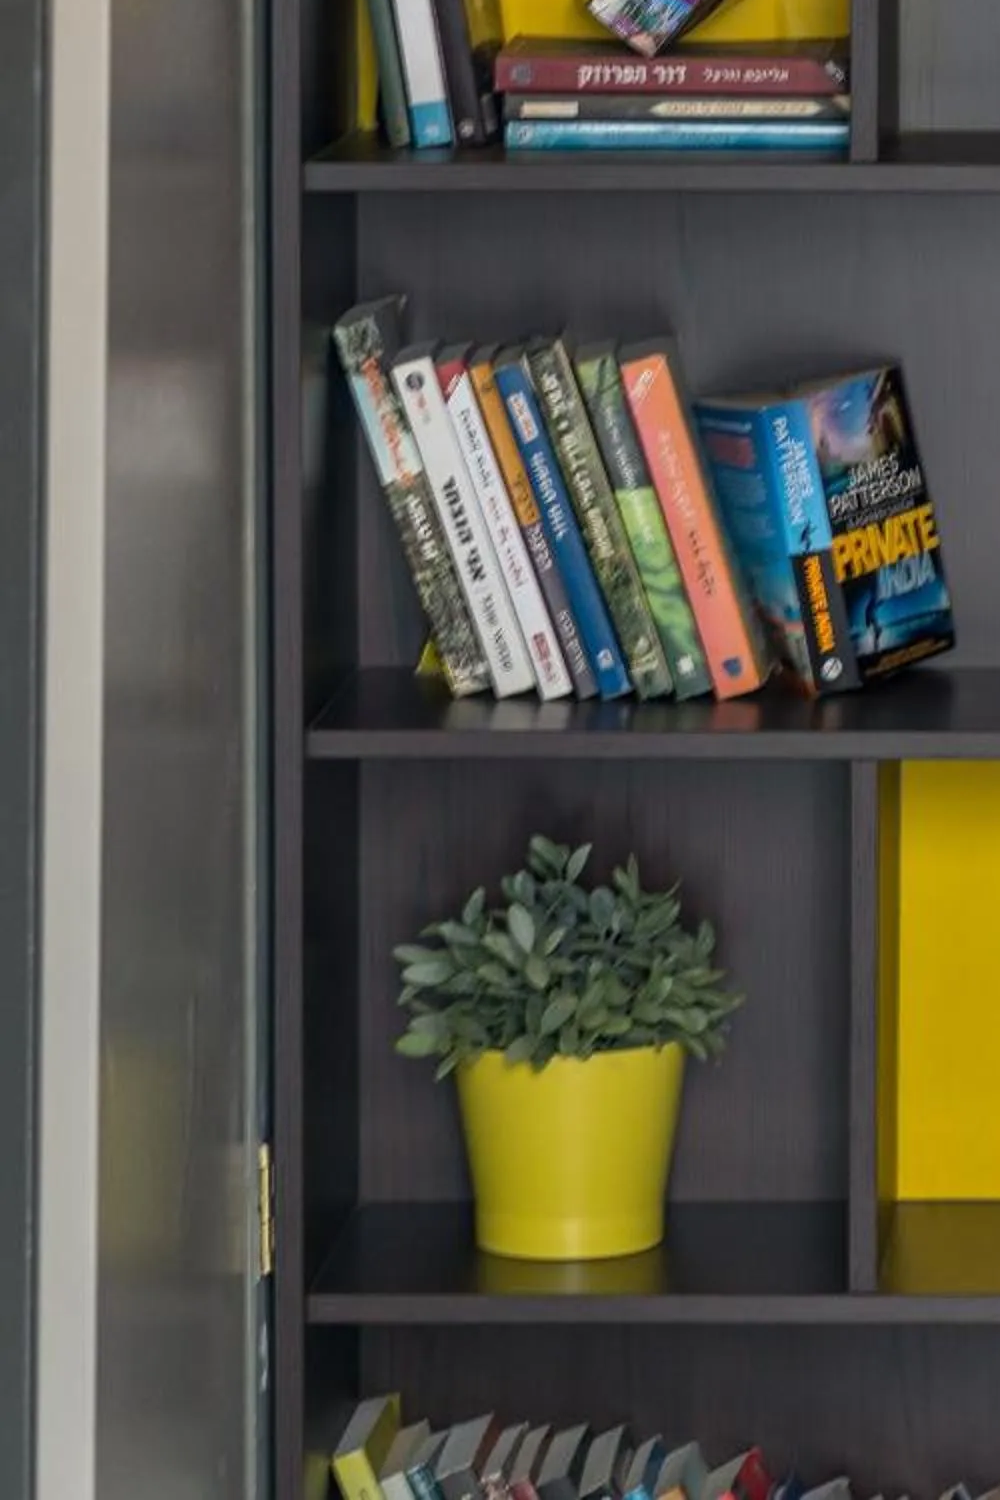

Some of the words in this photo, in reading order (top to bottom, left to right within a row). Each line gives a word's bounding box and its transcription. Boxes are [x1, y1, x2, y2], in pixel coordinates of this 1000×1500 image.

[577, 64, 647, 89] הפרוזק
[653, 64, 687, 85] דור
[773, 416, 805, 525] PATTERSON
[831, 465, 922, 518] PATTERSON
[849, 452, 900, 491] JAMES
[832, 501, 941, 584] PRIVATE
[878, 551, 937, 600] INDIA
